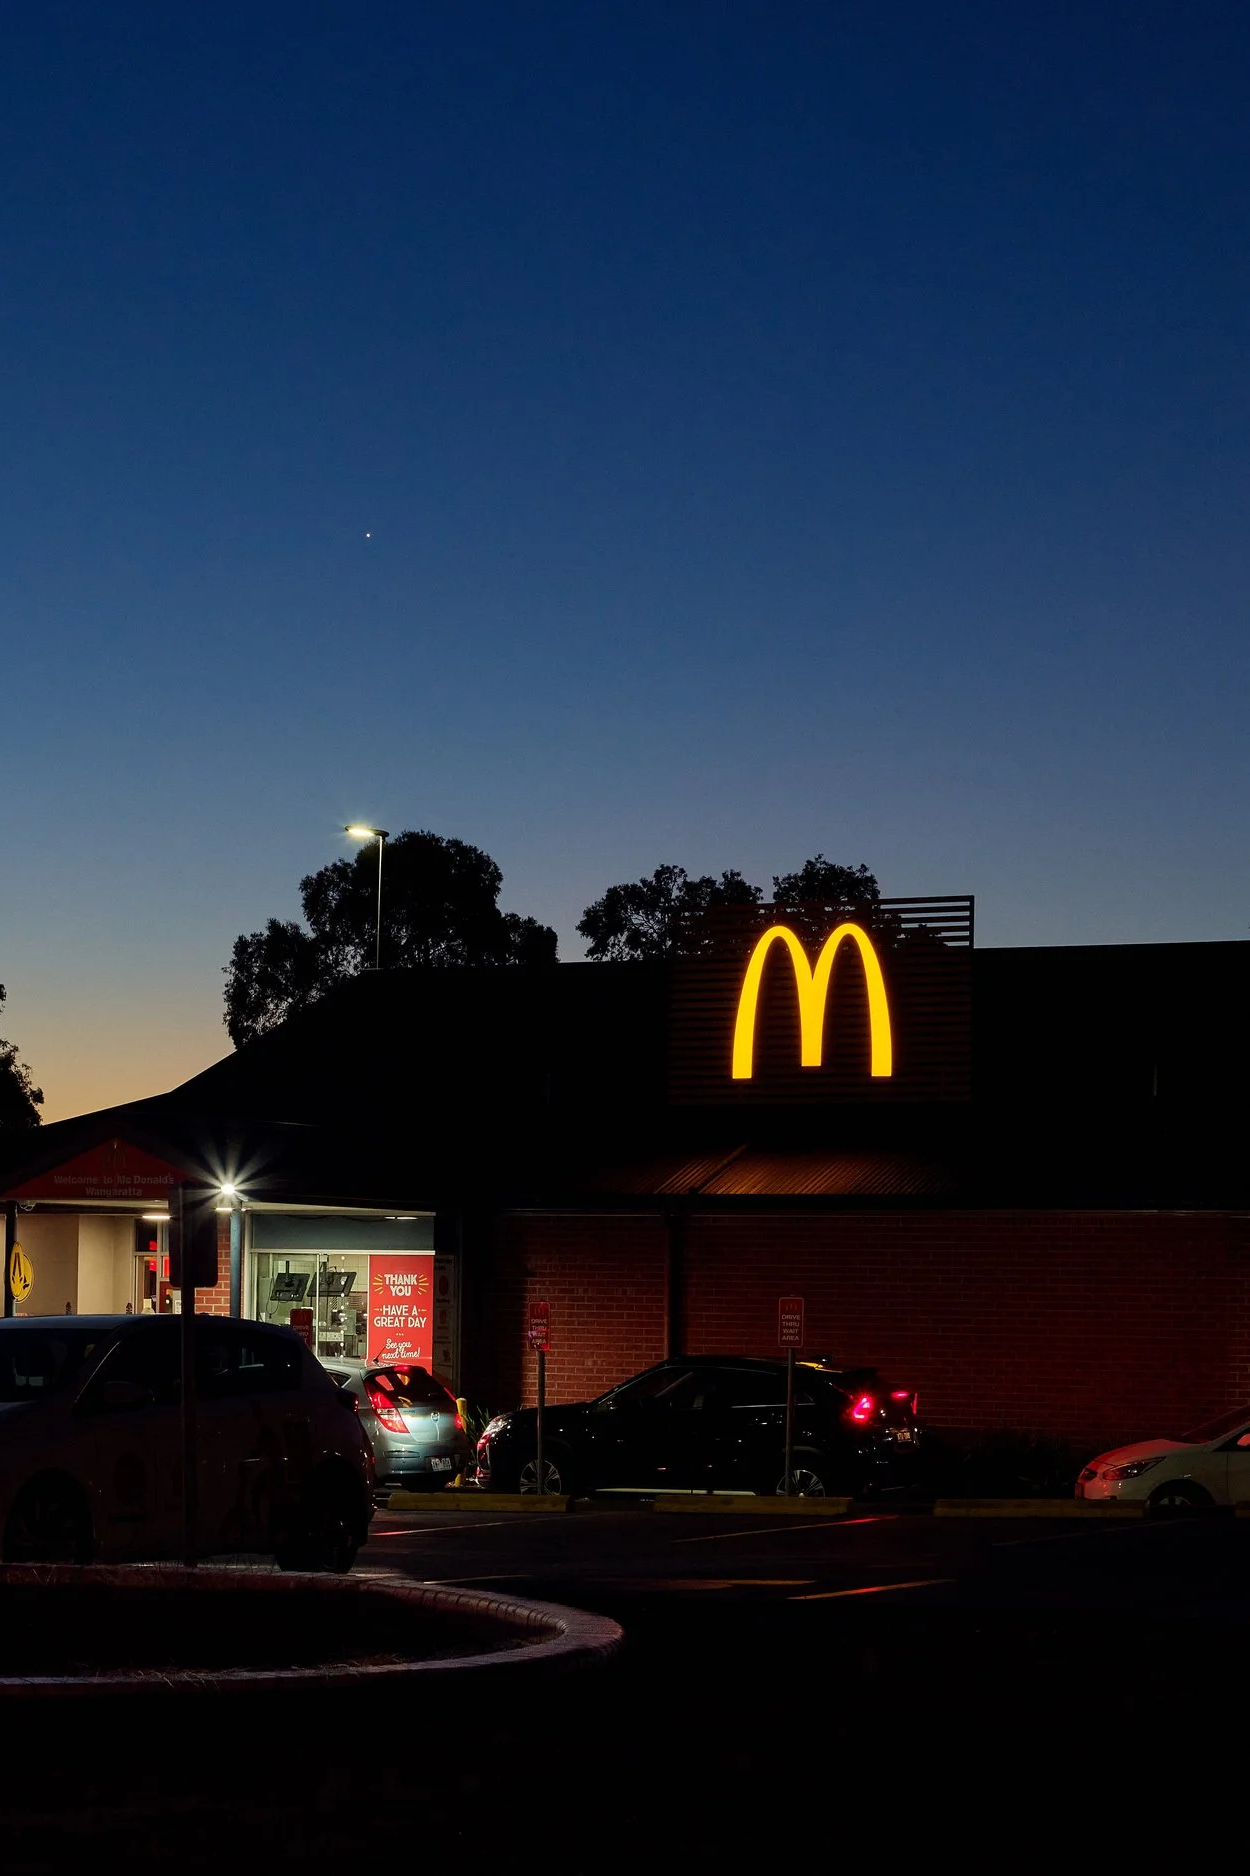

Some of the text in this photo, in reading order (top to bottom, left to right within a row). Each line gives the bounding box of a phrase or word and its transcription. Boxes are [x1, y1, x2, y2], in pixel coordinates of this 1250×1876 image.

[54, 1175, 98, 1185] Welcome
[103, 1175, 113, 1185] to
[85, 1187, 143, 1198] Wangaratta
[384, 1273, 418, 1285] THANK
[390, 1285, 411, 1297] YOU
[382, 1304, 418, 1316] HAVE A
[373, 1316, 427, 1328] GREAT DAY
[385, 1338, 412, 1352] See you
[381, 1346, 421, 1360] next time!
